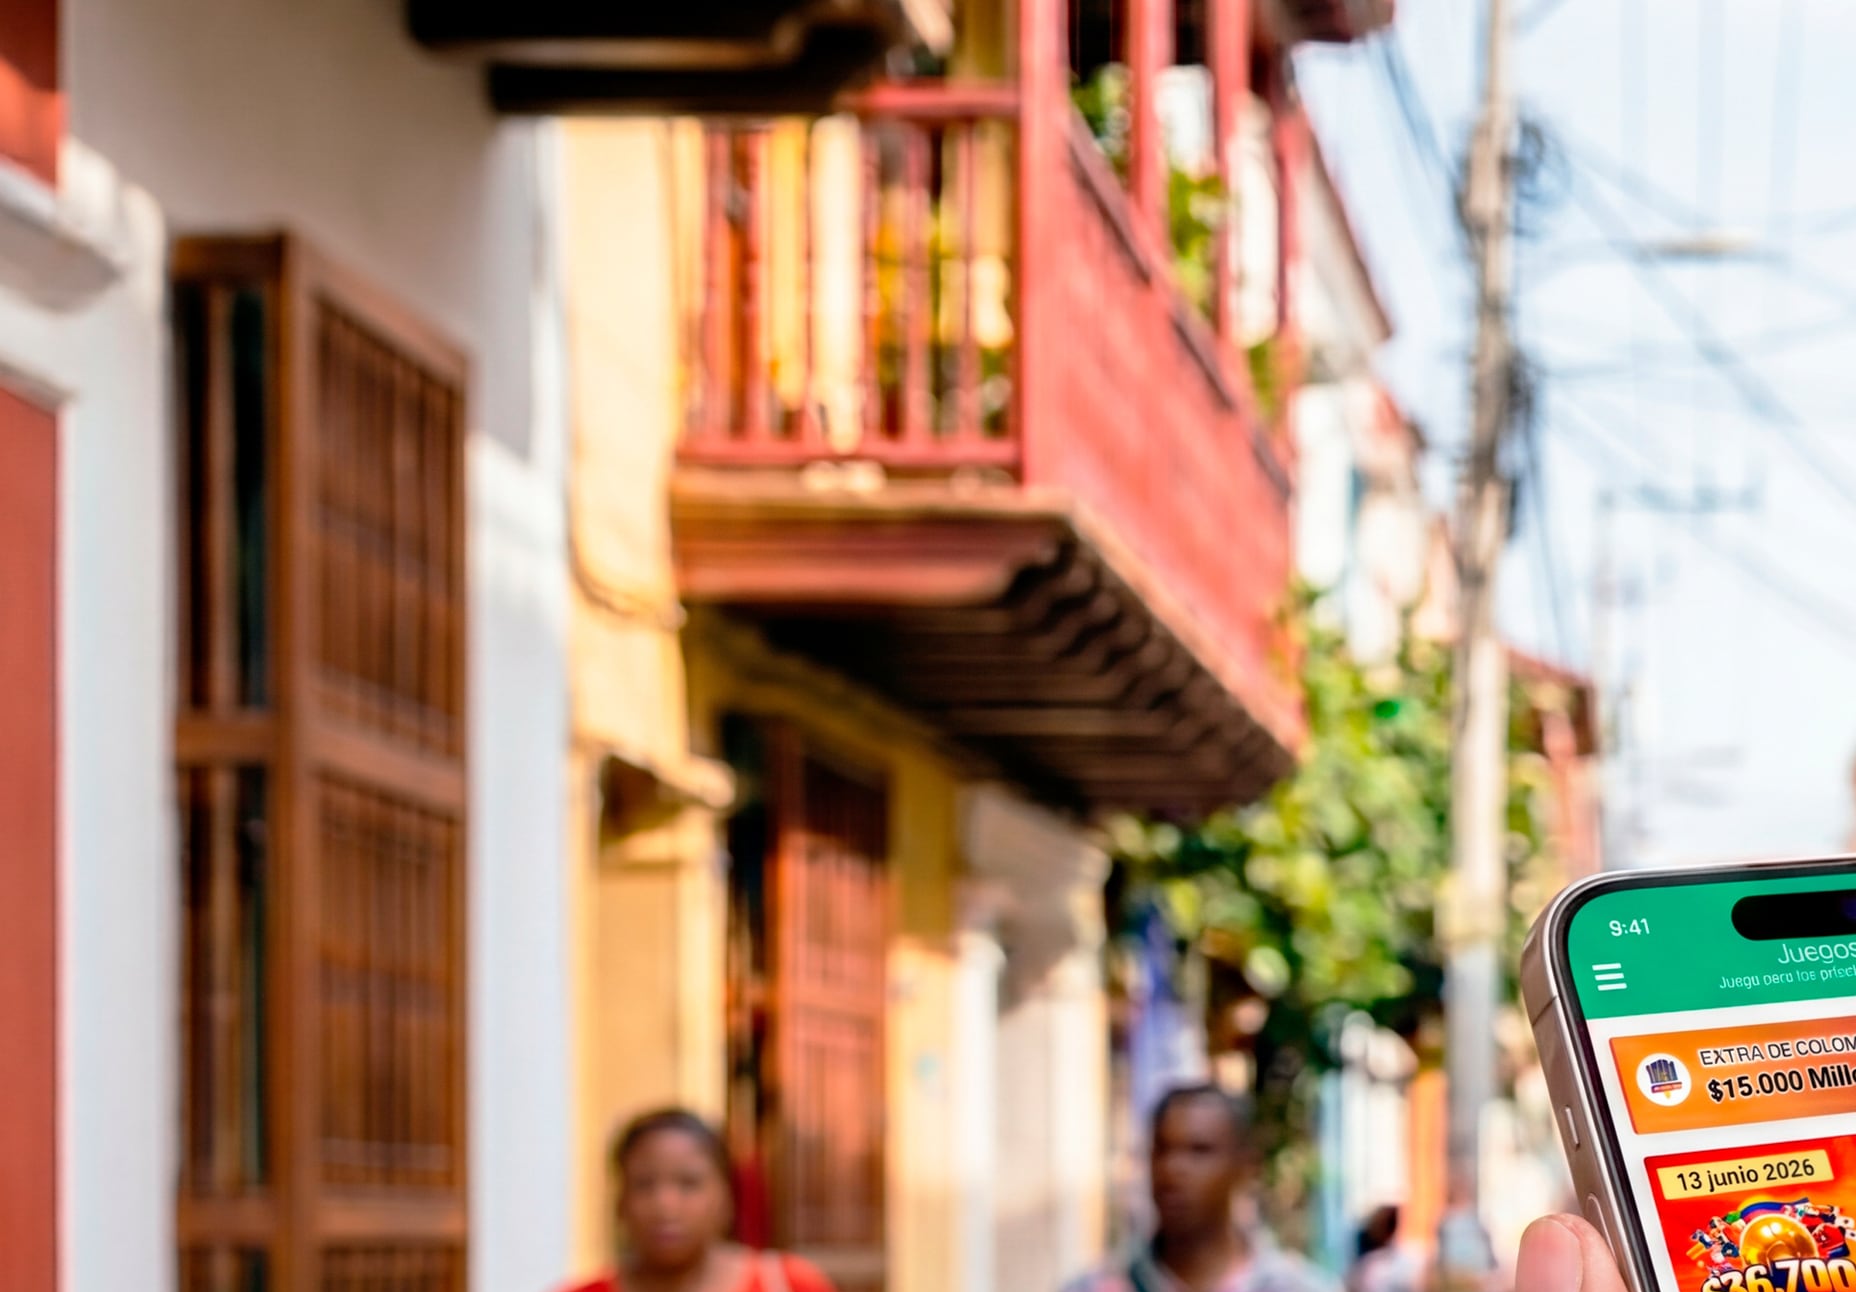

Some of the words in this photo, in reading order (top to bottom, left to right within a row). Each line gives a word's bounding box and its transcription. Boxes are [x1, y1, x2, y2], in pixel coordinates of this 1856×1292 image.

[1609, 918, 1651, 938] 9:41
[1700, 1045, 1765, 1066] EXTRA
[1767, 1042, 1793, 1059] DE
[1708, 1069, 1804, 1102] $15.000
[1676, 1172, 1702, 1192] 13
[1707, 1164, 1760, 1194] junio
[1763, 1158, 1816, 1181] 2026
